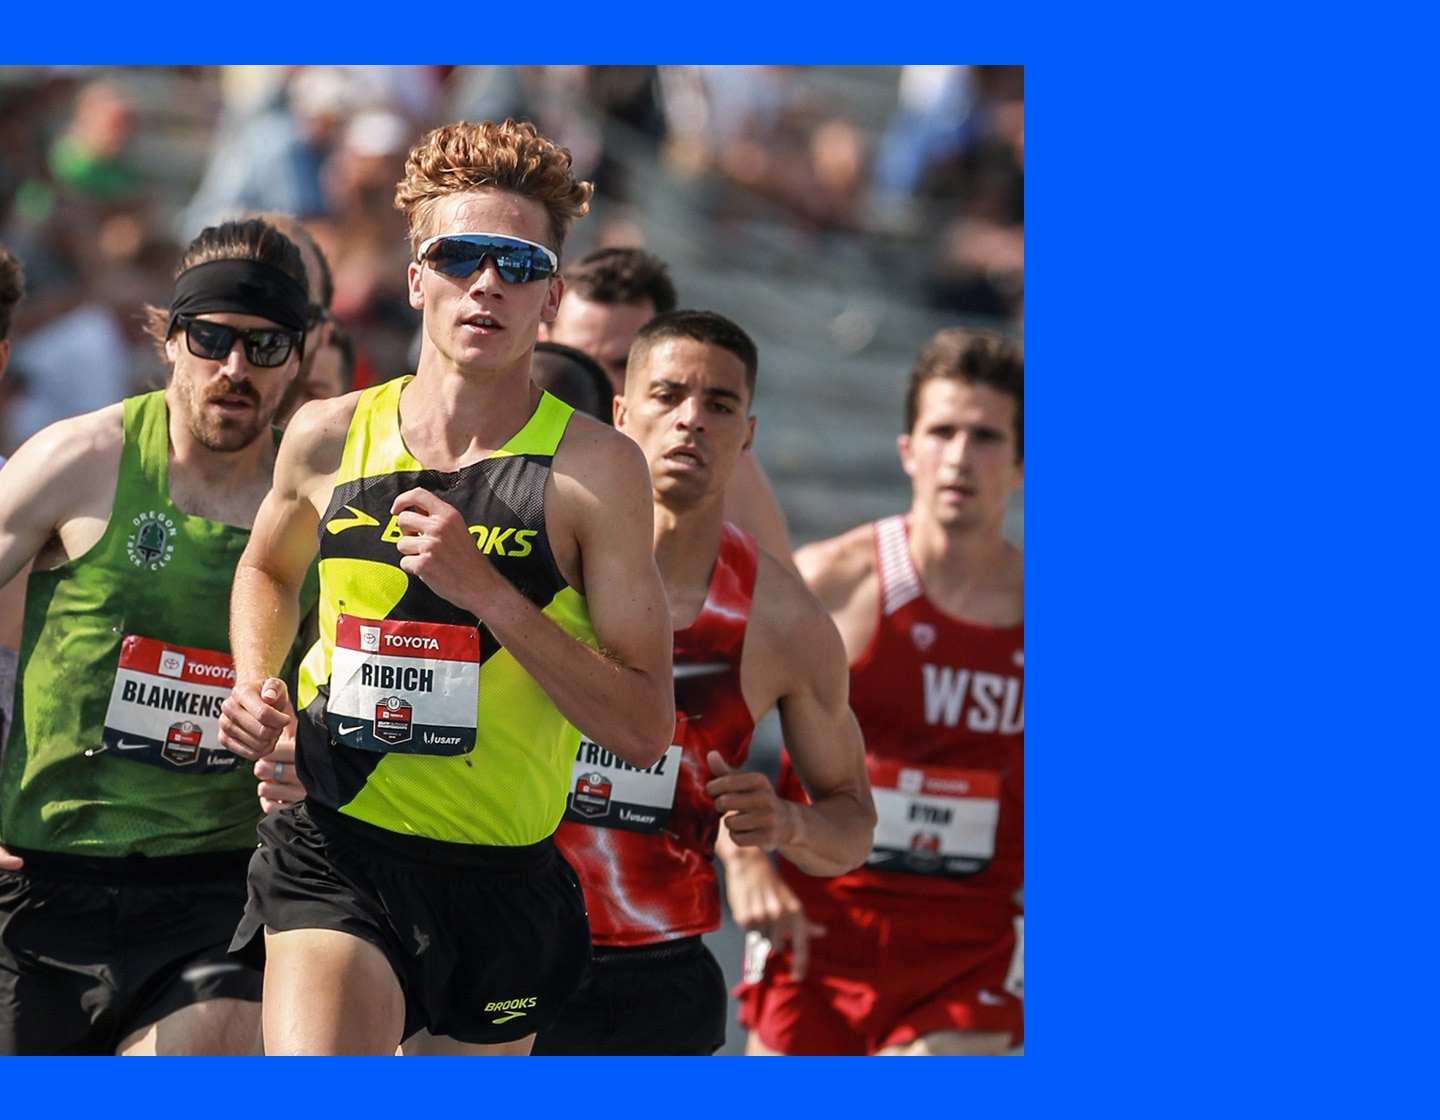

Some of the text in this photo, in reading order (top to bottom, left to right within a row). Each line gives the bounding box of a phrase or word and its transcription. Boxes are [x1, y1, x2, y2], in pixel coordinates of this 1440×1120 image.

[133, 510, 177, 536] OREGON
[380, 514, 538, 557] BOKS
[127, 534, 174, 571] TRACK CLUB
[384, 634, 439, 650] TOYOTA
[188, 662, 236, 680] TOYOTA
[361, 663, 434, 693] RIBICH
[122, 680, 225, 719] BLANKENS
[434, 736, 462, 745] USATF
[484, 997, 537, 1012] BROOKS
